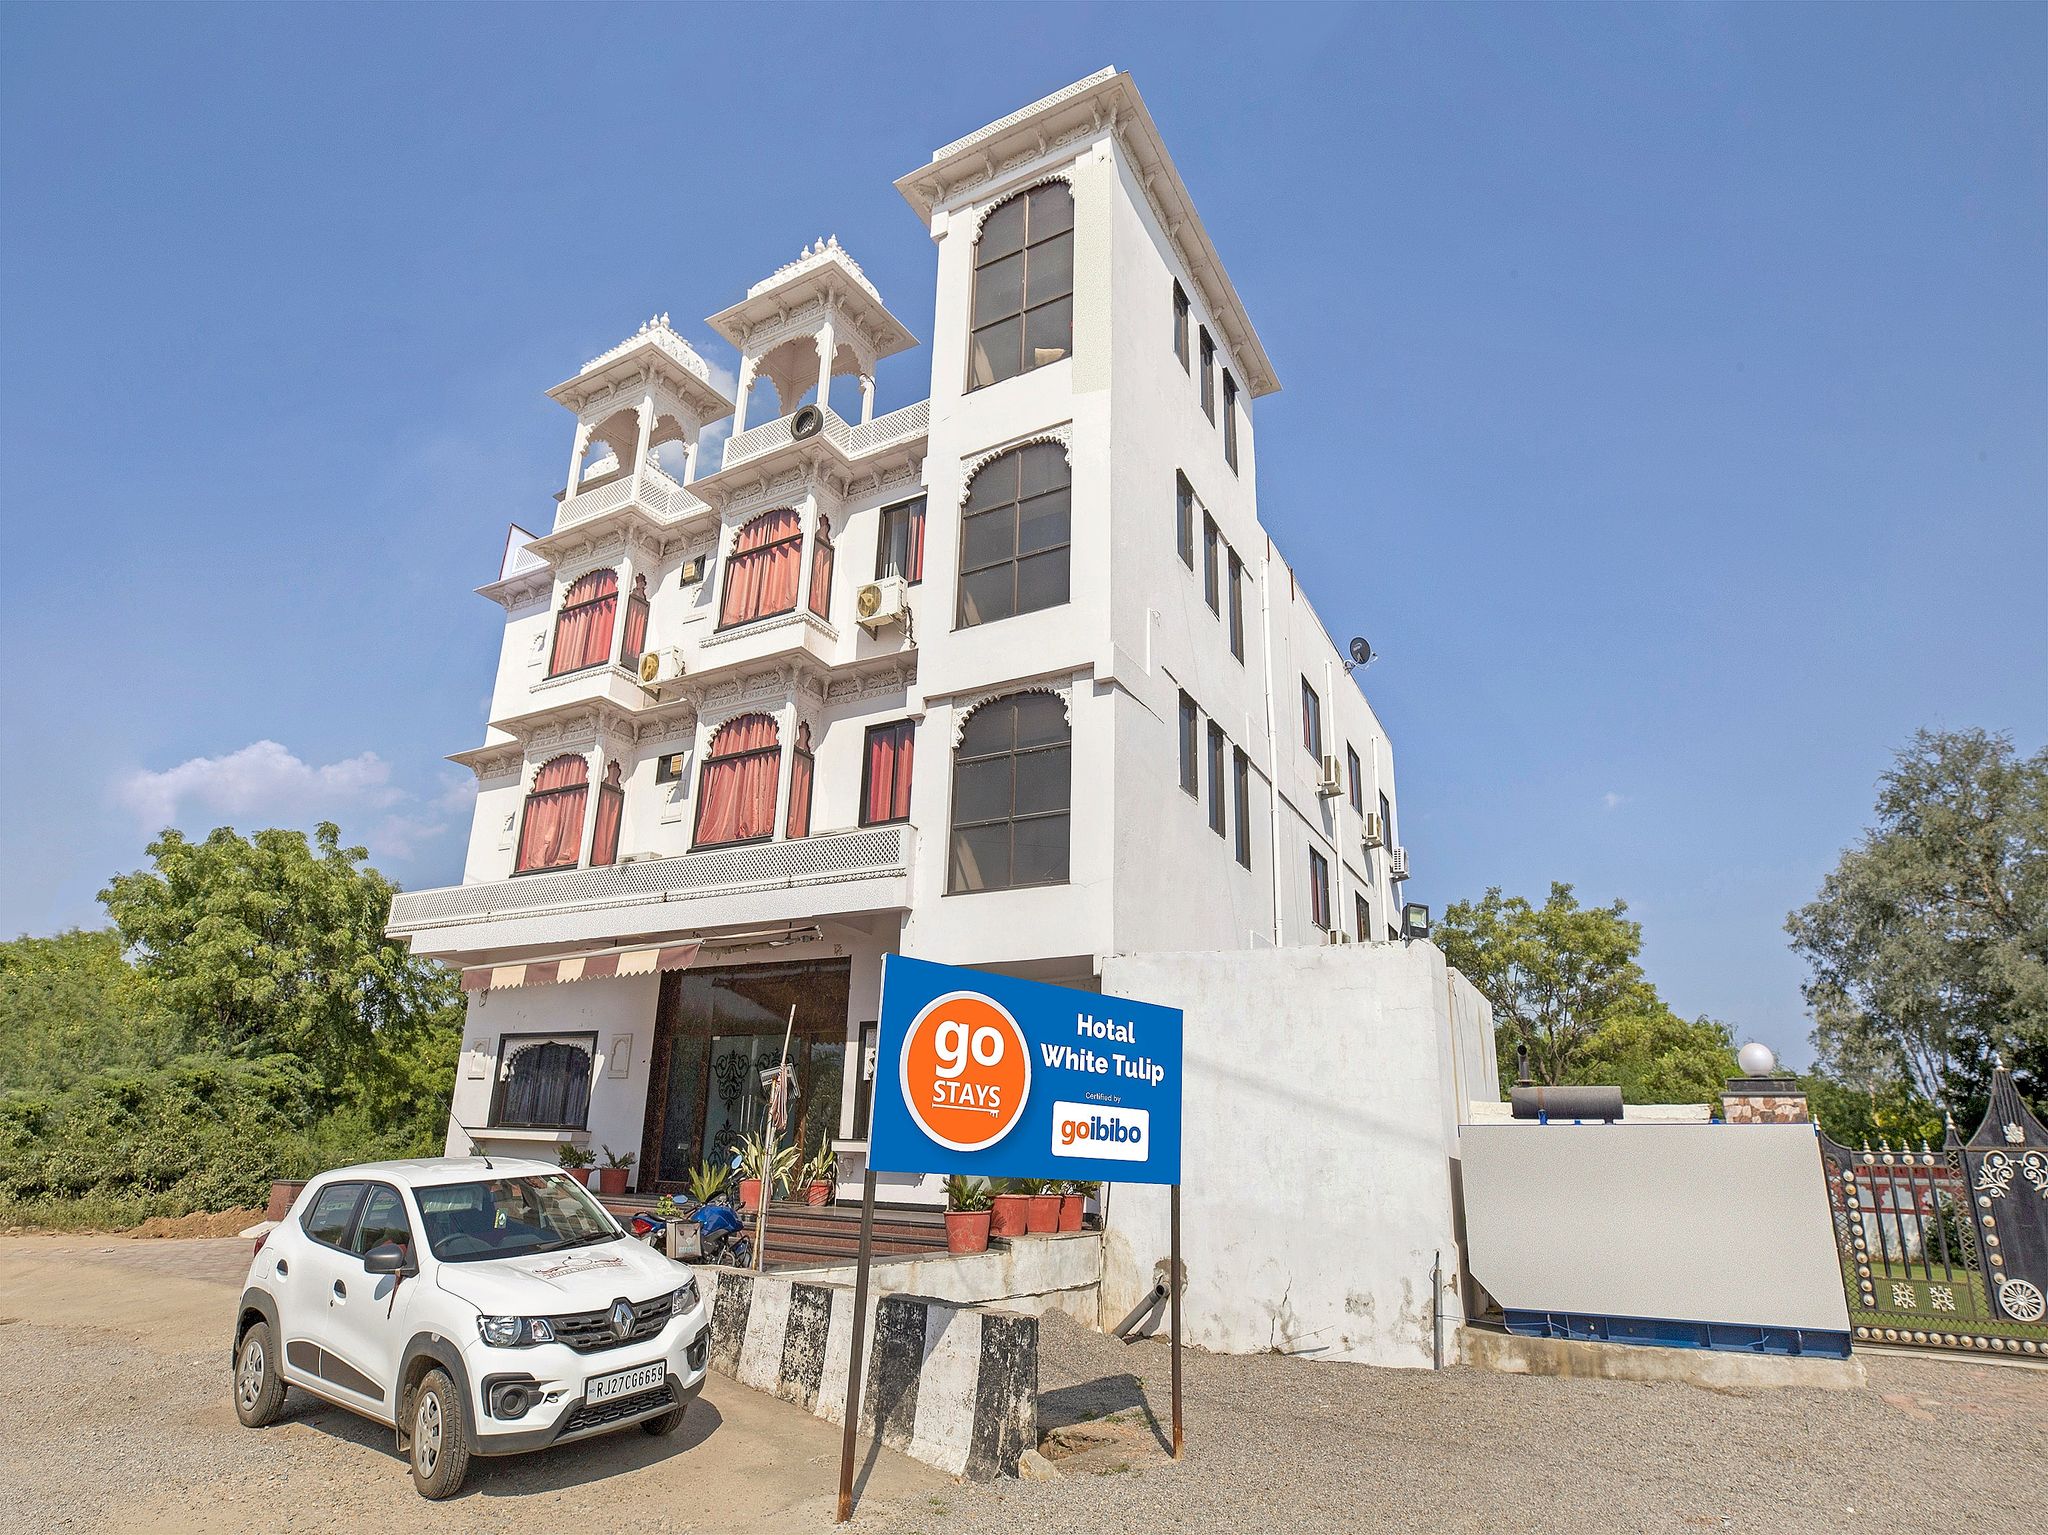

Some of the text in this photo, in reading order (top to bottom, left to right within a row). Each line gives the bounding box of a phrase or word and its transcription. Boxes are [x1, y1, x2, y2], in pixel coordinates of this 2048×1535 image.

[1077, 1013, 1136, 1044] Hotal
[934, 1020, 1004, 1079] go
[1040, 1042, 1165, 1087] White Tulip
[932, 1080, 1001, 1108] STAYS
[1085, 1091, 1121, 1104] Certified by
[1061, 1116, 1142, 1145] goibibo
[596, 1366, 663, 1398] RJ27CG6659
